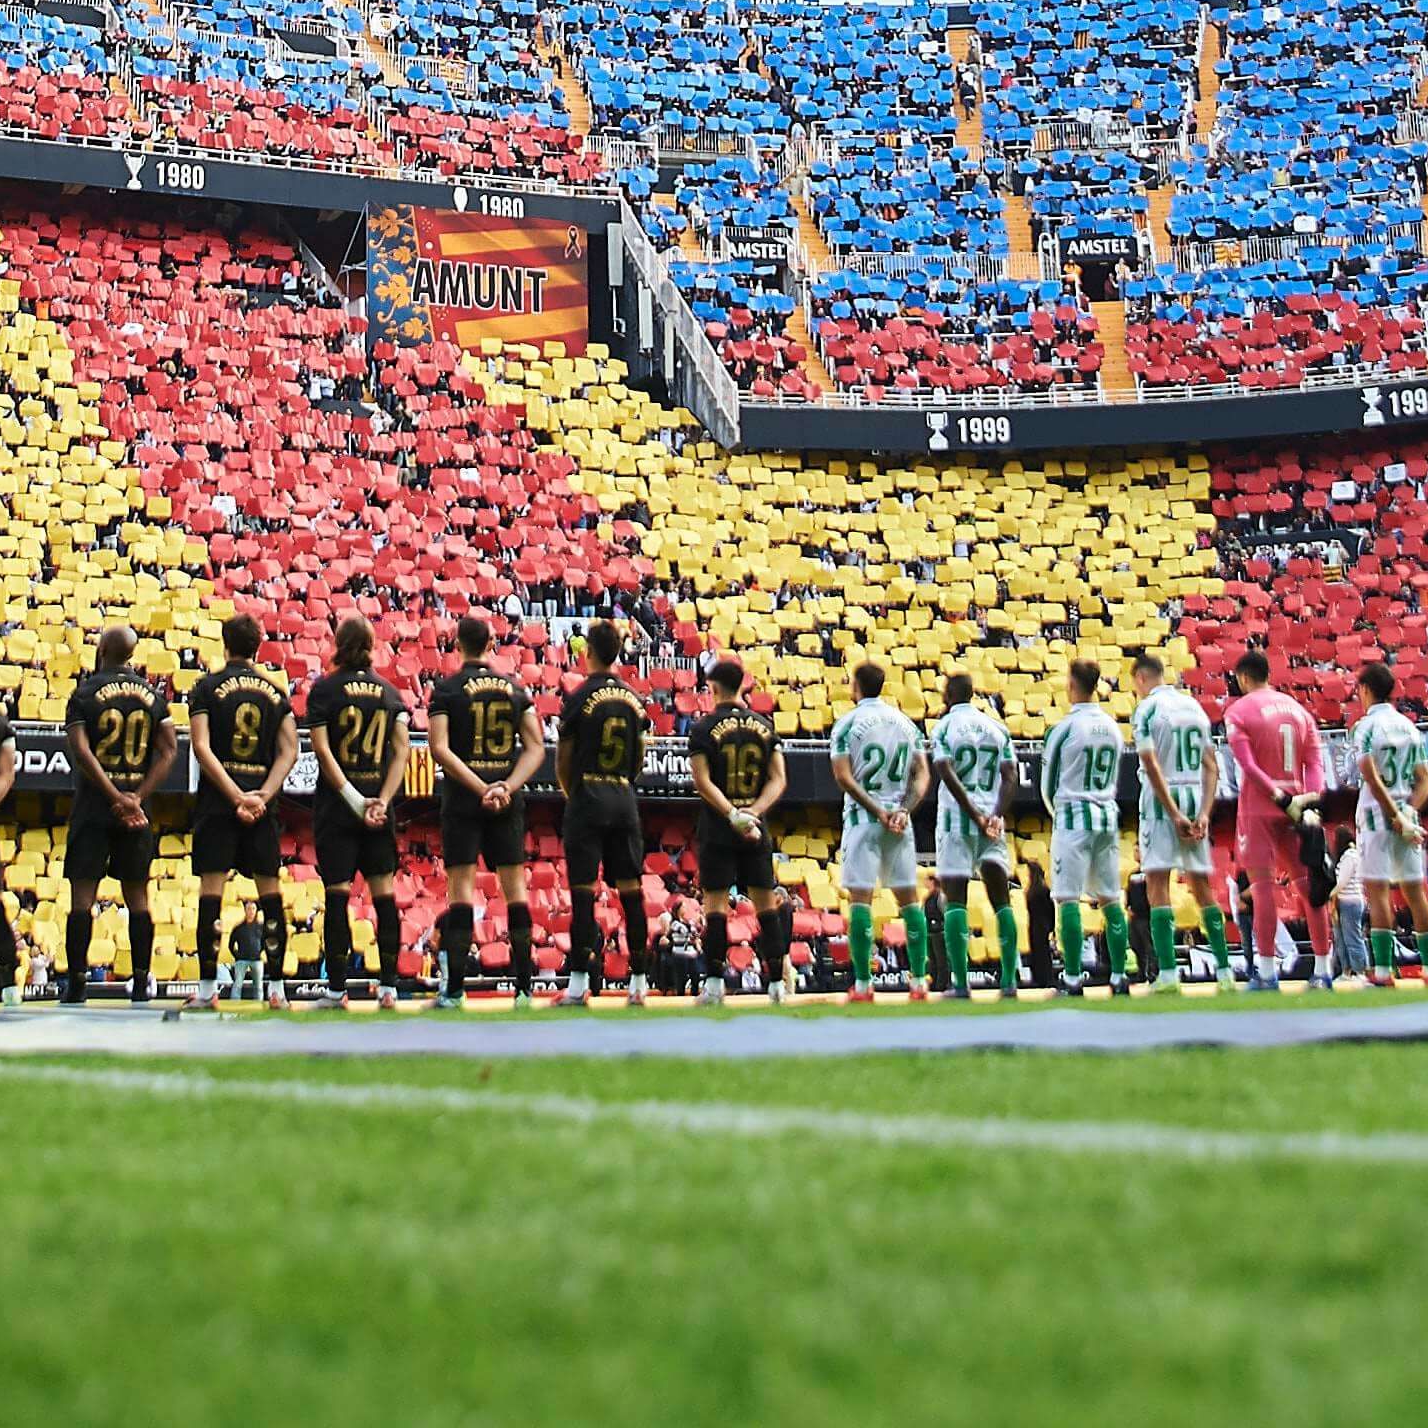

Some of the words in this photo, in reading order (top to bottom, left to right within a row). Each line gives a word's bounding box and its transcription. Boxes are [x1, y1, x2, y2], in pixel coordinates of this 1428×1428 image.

[156, 161, 205, 189] 1980
[480, 194, 525, 219] 1980
[729, 241, 787, 260] AMSTEL
[1067, 239, 1130, 256] AMSTEL
[411, 257, 549, 316] AMUNT
[957, 415, 1011, 443] 1999
[95, 708, 152, 766] 20
[231, 702, 262, 758] 8
[338, 704, 389, 764] 24
[469, 700, 515, 756] 15
[598, 717, 628, 770] 5
[1172, 726, 1202, 772] 16
[1278, 723, 1294, 772] 1
[721, 742, 762, 795] 16
[863, 742, 909, 791] 24
[955, 745, 1000, 792] 23
[1083, 745, 1116, 791] 19
